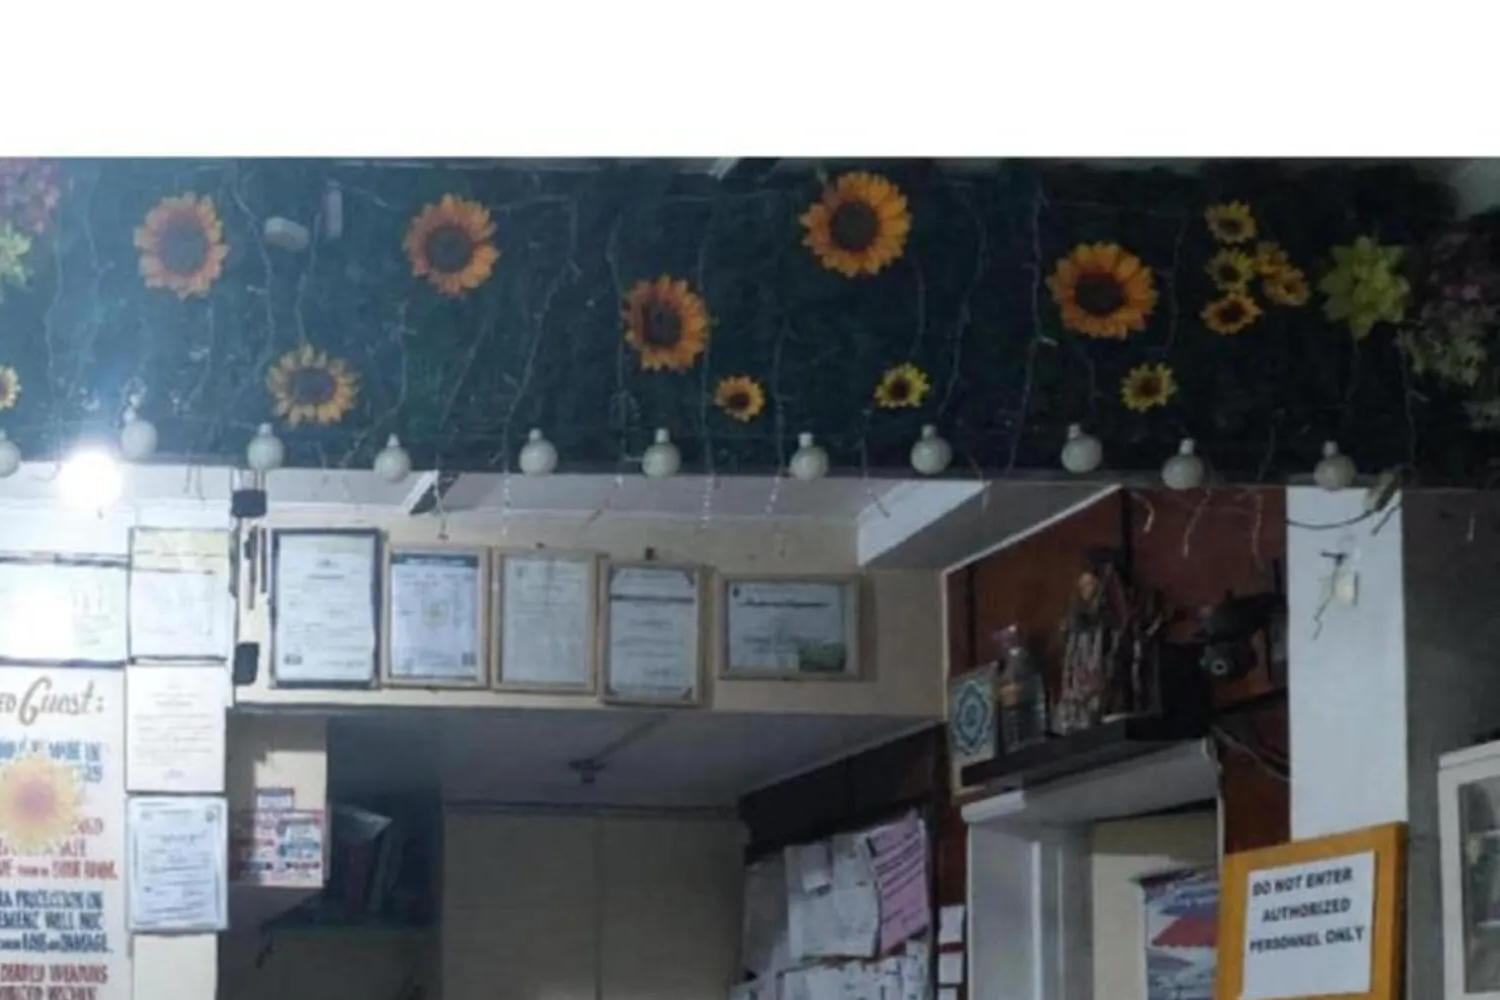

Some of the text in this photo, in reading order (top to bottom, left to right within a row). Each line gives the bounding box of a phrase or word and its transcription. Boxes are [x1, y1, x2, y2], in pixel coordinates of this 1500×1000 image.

[1253, 866, 1352, 896] DO NOT ENTER
[1263, 897, 1351, 922] AUTHORIZED
[1250, 925, 1365, 953] PERSONNEL ONLY
[0, 964, 45, 982] DEADLY
